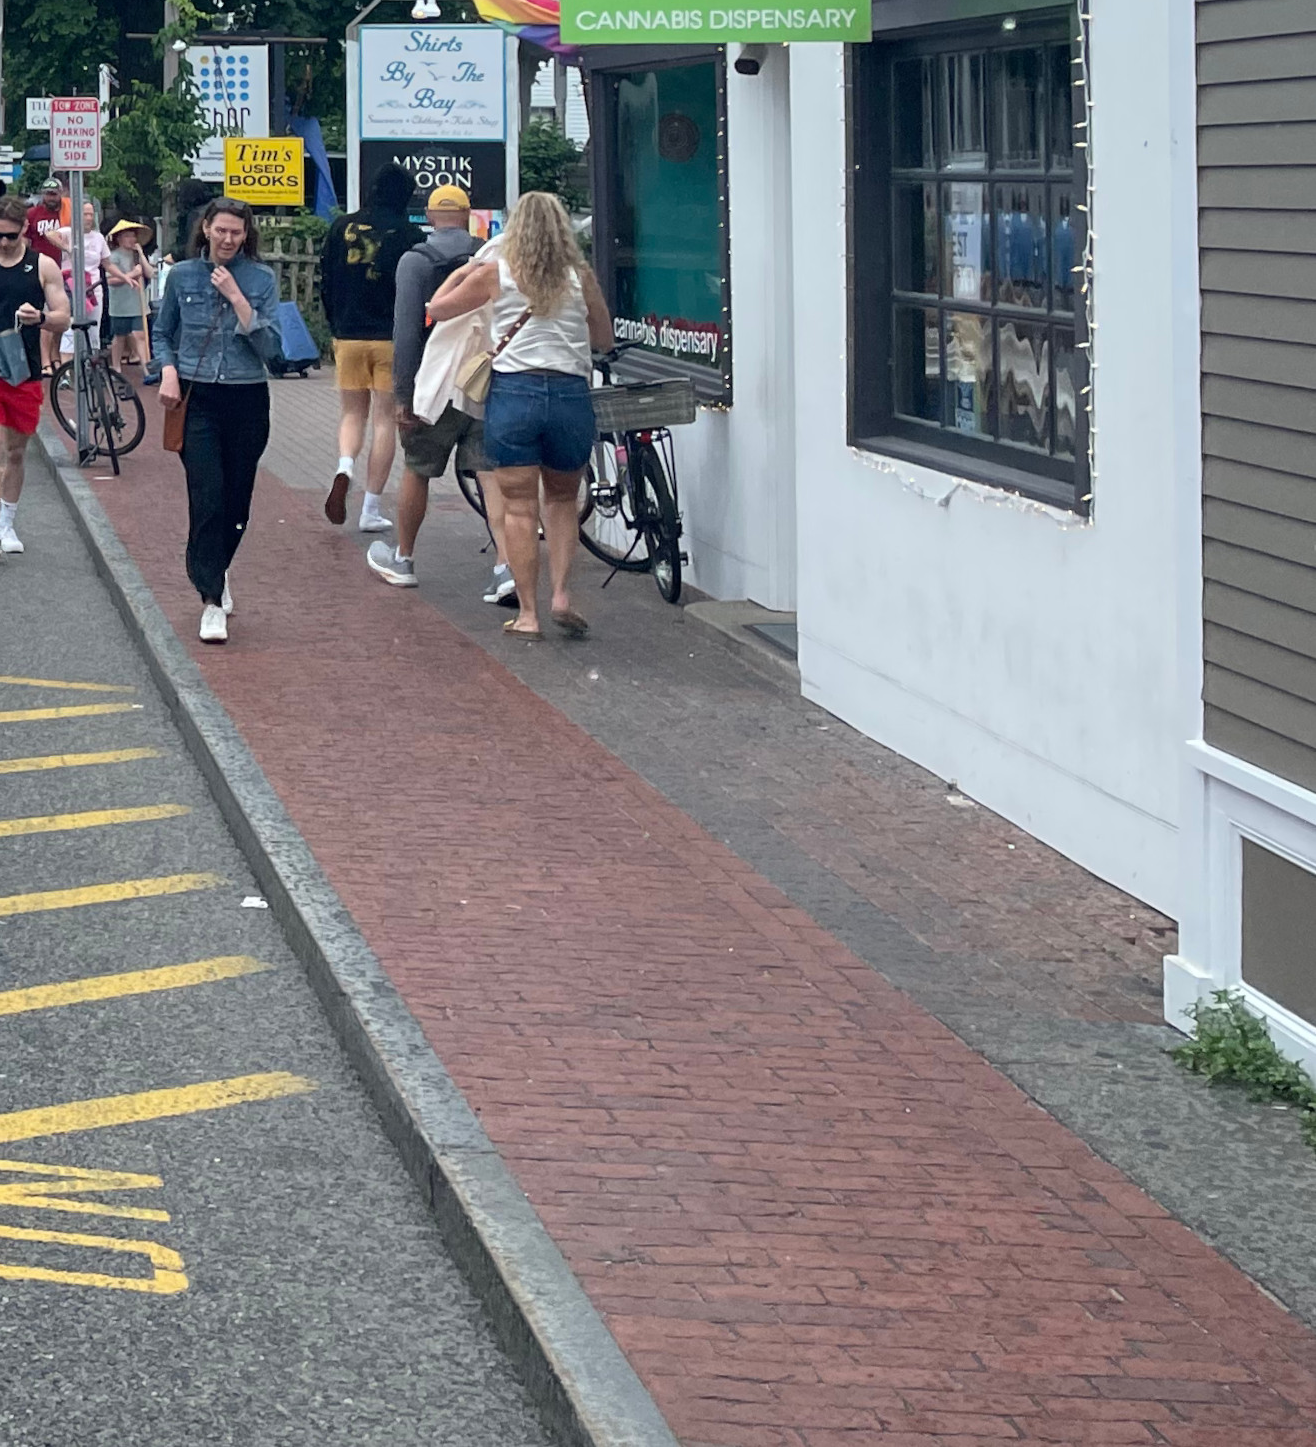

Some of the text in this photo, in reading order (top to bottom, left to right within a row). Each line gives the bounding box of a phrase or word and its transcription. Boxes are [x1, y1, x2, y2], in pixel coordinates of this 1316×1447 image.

[575, 8, 857, 31] CANNABIS DISPENSARY
[404, 30, 463, 52] Shirts
[380, 61, 485, 89] By The
[31, 101, 51, 111] TH
[53, 100, 96, 111] TOW ZONE
[408, 88, 457, 117] Bay
[31, 116, 51, 126] GA
[67, 116, 84, 125] NO
[55, 127, 96, 137] PARKING
[58, 139, 92, 149] EITHER
[64, 151, 87, 161] SIDE
[235, 143, 294, 163] Tim's
[241, 164, 286, 174] USED
[393, 155, 473, 171] MYSTIK
[228, 175, 299, 188] BOOKS
[415, 172, 472, 189] OON
[613, 316, 719, 362] cannabis dispensary
